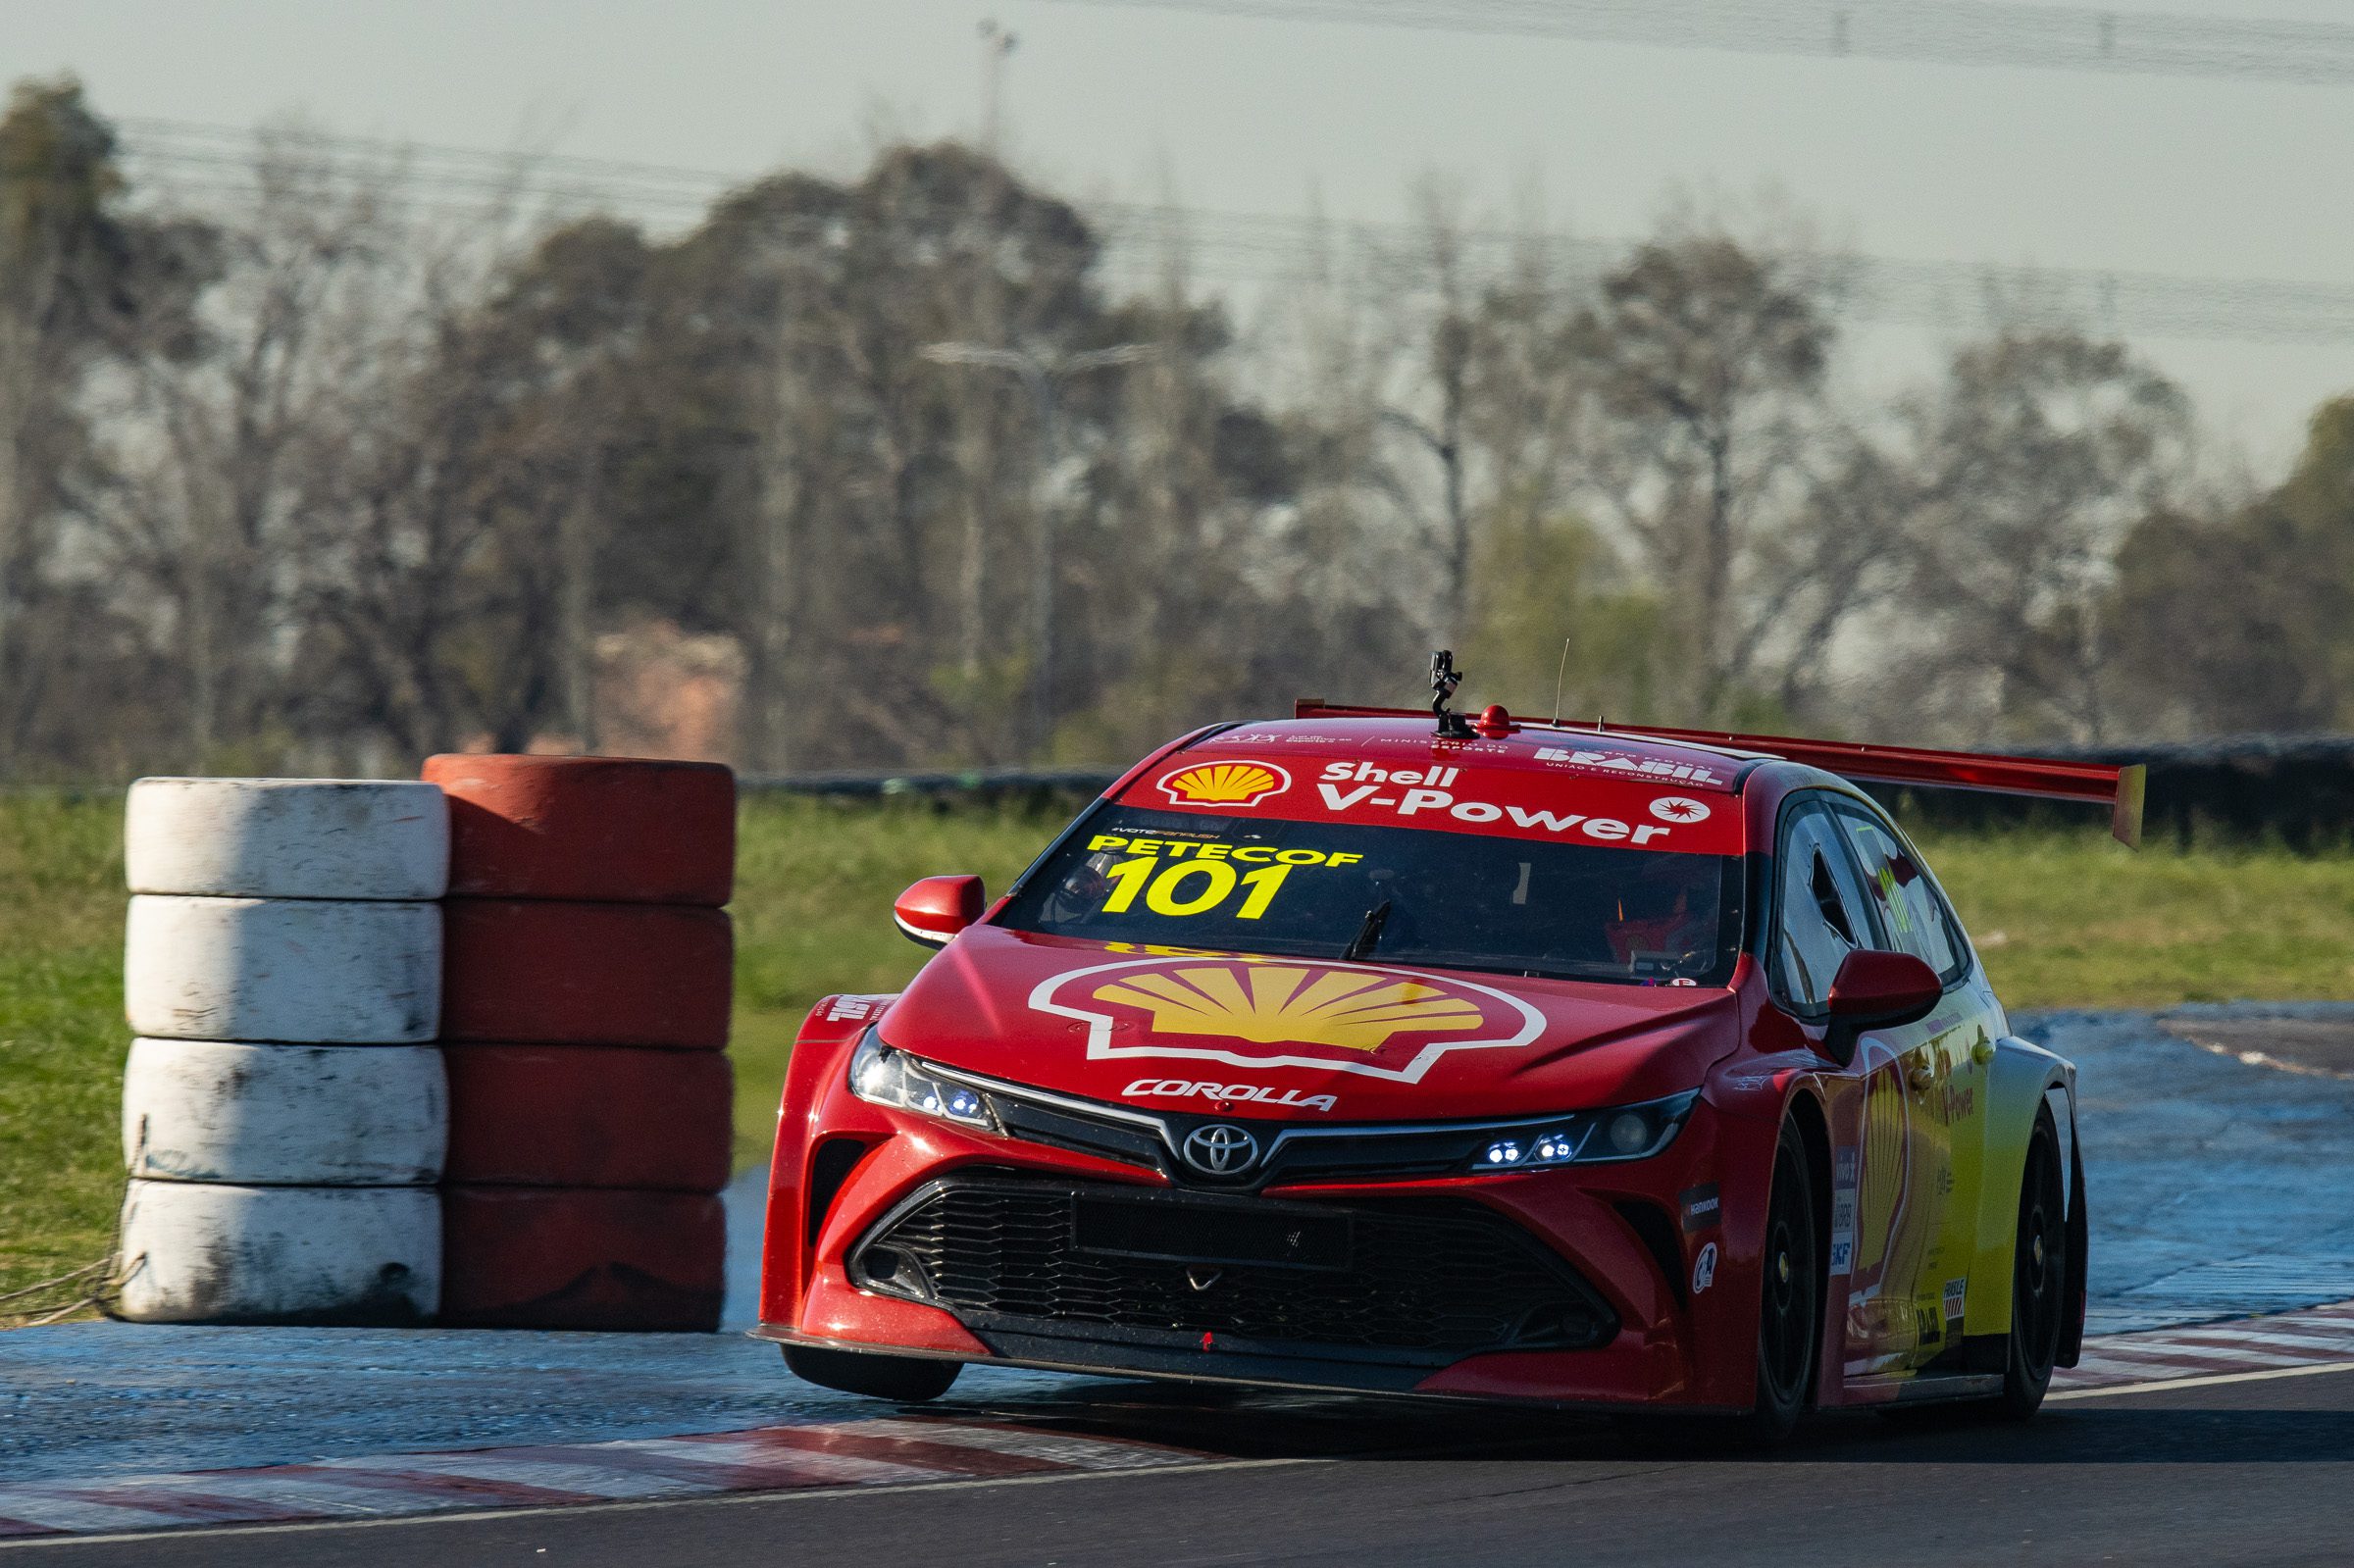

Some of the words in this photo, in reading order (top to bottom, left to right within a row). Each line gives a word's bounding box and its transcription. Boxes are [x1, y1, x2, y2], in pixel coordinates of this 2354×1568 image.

[1319, 760, 1459, 788] Shell
[1533, 746, 1723, 785] BRASIL
[1603, 768, 1705, 787] RECONSTRUÇÃO
[1316, 782, 1672, 845] V-Power
[1087, 835, 1364, 868] PETECOF
[1101, 856, 1294, 920] 101
[1121, 1079, 1339, 1112] COROLLA
